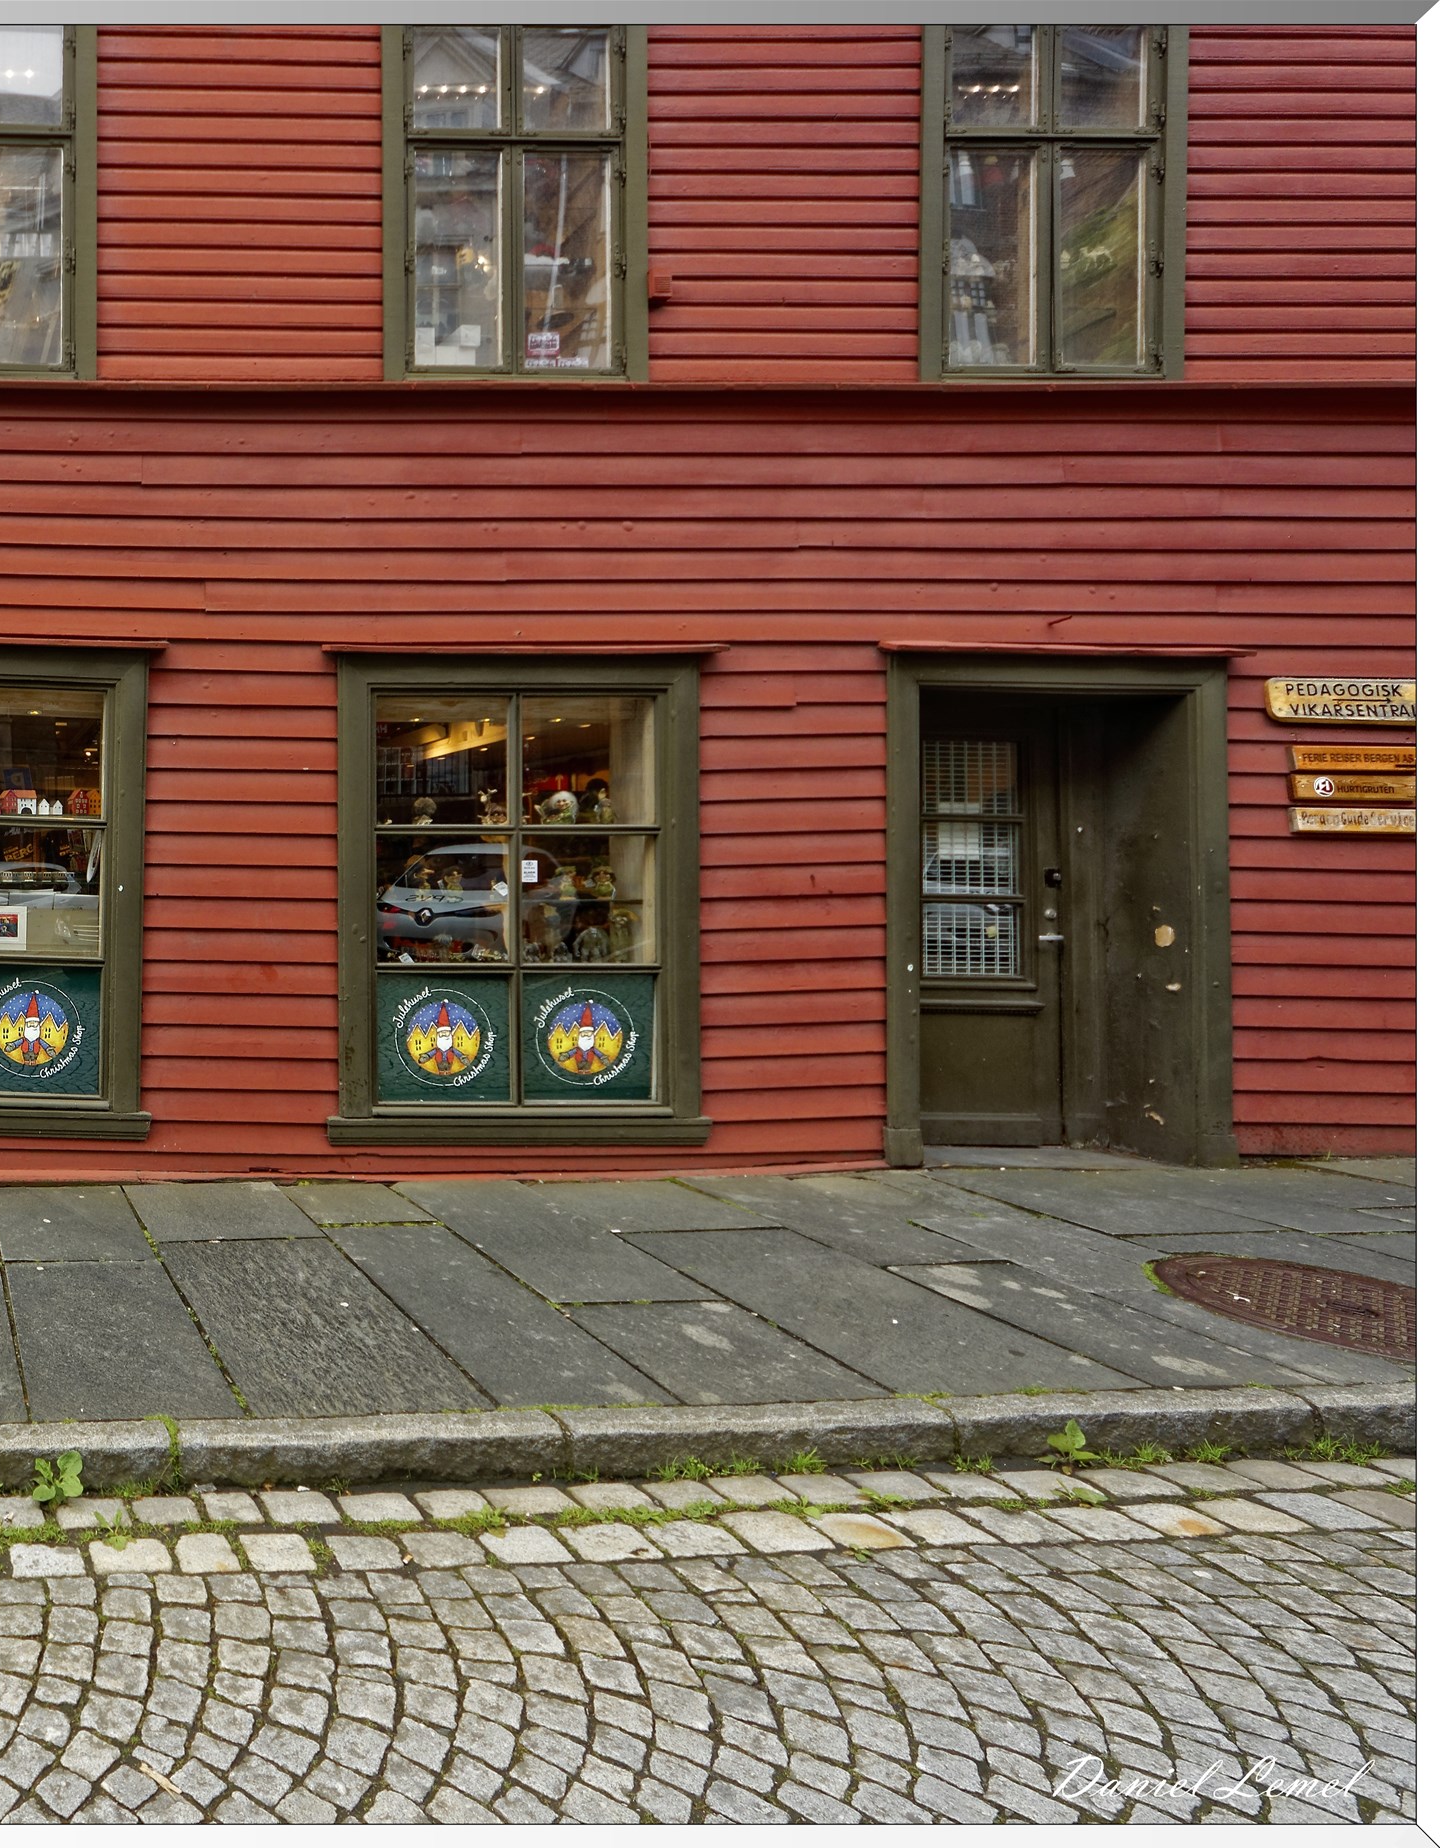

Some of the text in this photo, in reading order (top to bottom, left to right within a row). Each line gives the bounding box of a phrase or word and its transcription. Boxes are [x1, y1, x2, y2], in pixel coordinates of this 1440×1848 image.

[1285, 683, 1403, 697] PEDAGOGISK
[1302, 753, 1414, 764] FERIE REISER BERGEN AS
[392, 986, 431, 1029] Julehuset
[534, 986, 574, 1029] Julehuset
[39, 1024, 86, 1079] Christmas Shop
[453, 1031, 497, 1087] Christmas Shop
[593, 1031, 639, 1086] Christmas Shop
